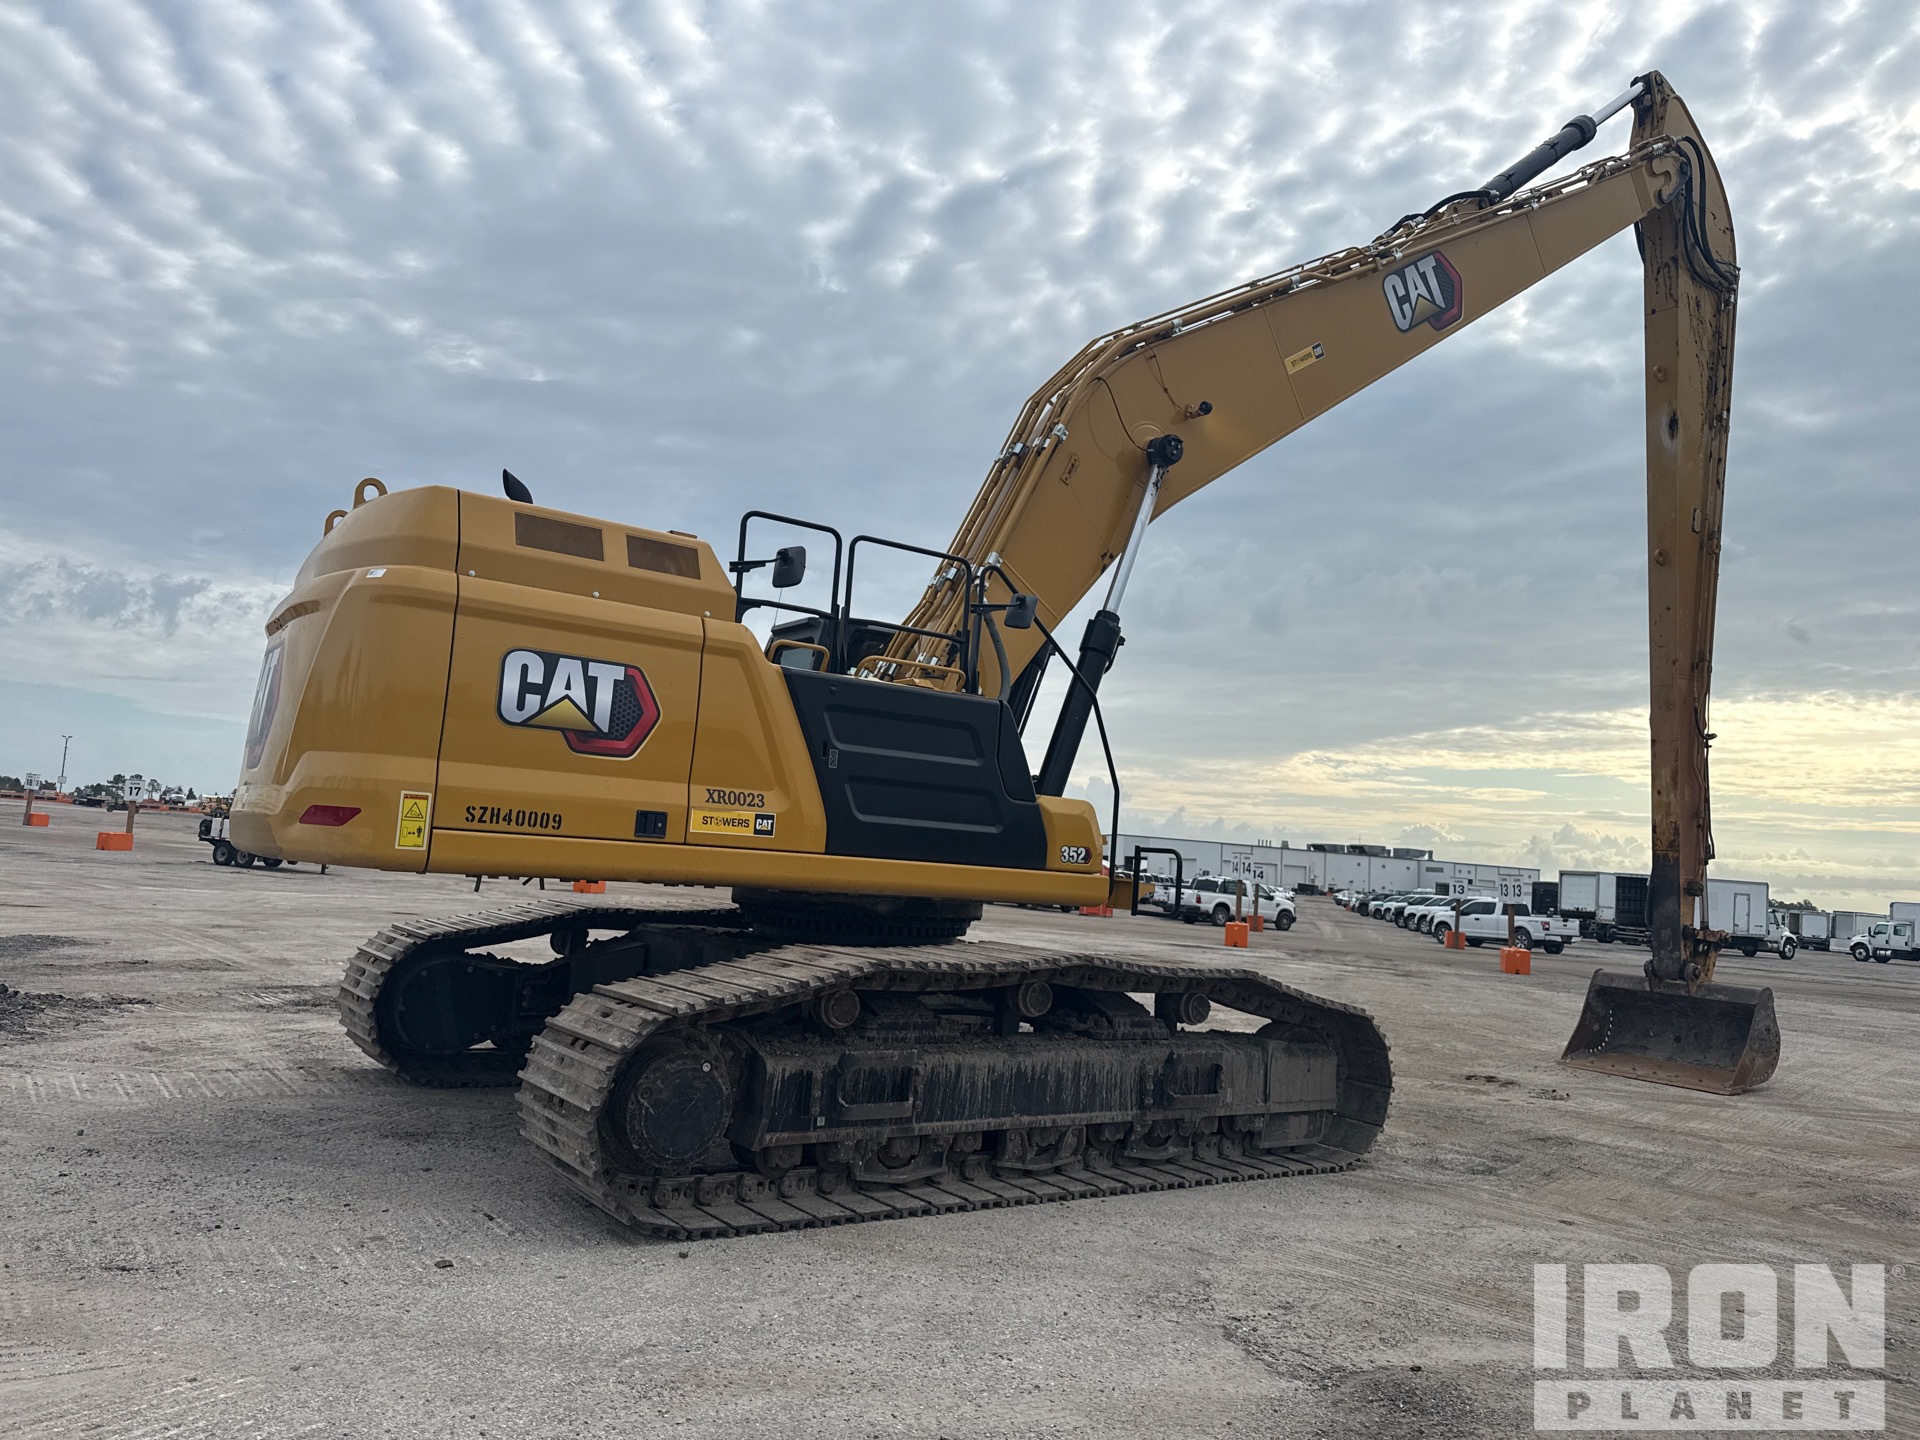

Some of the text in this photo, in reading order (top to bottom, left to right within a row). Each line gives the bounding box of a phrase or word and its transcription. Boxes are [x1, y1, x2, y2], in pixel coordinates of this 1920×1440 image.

[1383, 254, 1446, 331] CAT
[500, 650, 625, 733] CAT
[128, 786, 142, 796] 17
[705, 788, 766, 808] XR0023
[465, 805, 562, 830] SZH40009
[756, 818, 773, 831] CAT
[1060, 845, 1086, 864] 352
[1232, 861, 1239, 874] 14
[1242, 861, 1252, 875] 14
[1253, 869, 1265, 880] 14
[1452, 884, 1465, 895] 13
[1500, 883, 1509, 897] 13
[1512, 884, 1522, 897] 13
